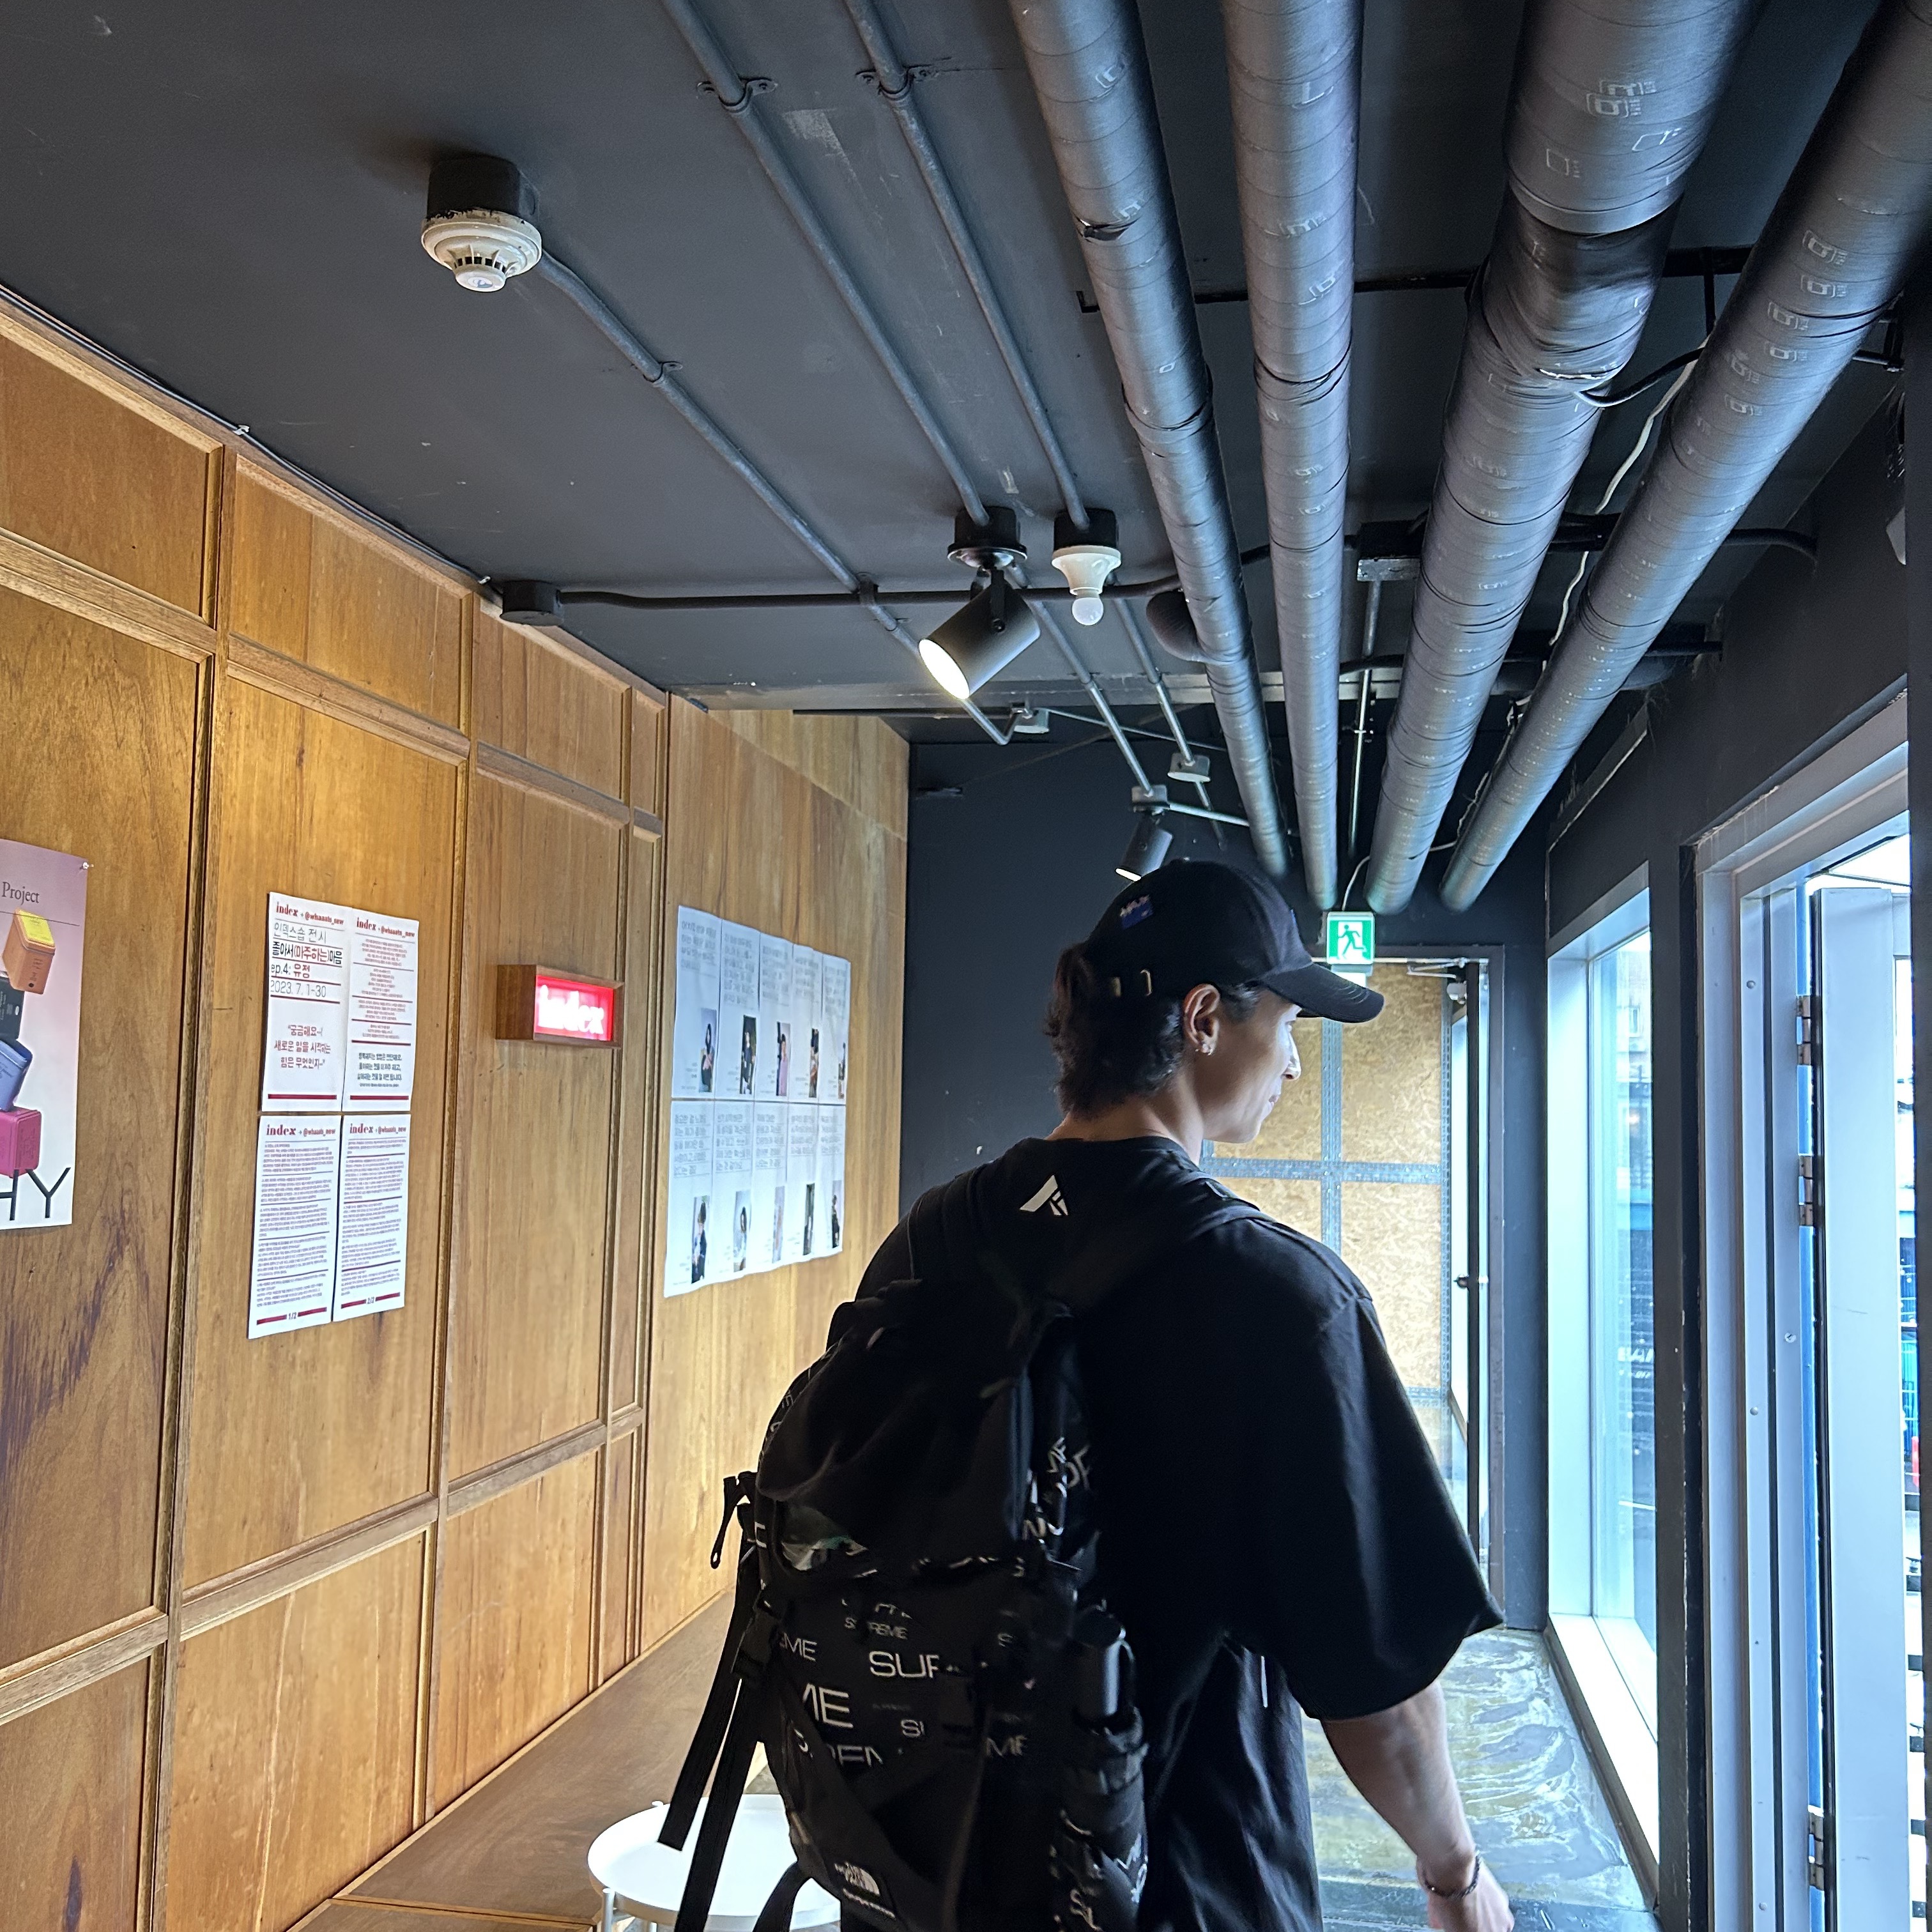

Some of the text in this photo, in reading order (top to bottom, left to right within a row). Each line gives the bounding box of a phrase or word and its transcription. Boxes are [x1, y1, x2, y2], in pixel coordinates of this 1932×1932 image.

[2, 882, 40, 905] Project
[276, 901, 298, 917] index
[356, 917, 377, 931] index
[309, 929, 326, 944] 전시
[294, 963, 310, 979] 유정
[274, 1040, 294, 1052] 새로운
[266, 1124, 296, 1135] index
[349, 1123, 374, 1133] index
